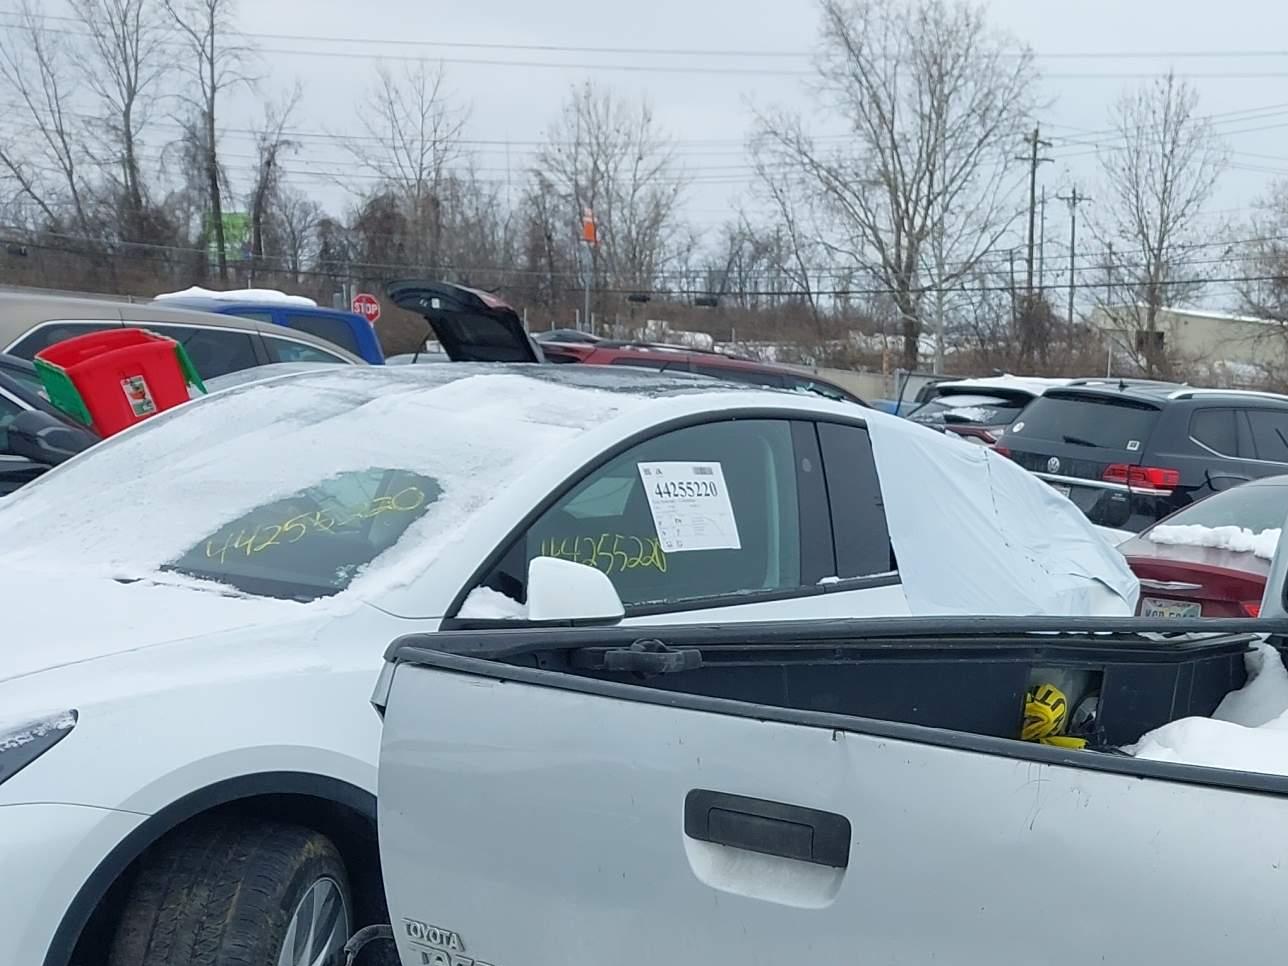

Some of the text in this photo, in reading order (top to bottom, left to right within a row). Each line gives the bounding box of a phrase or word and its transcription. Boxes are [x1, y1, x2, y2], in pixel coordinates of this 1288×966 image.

[354, 302, 378, 314] STOP
[655, 481, 718, 499] 44255220
[401, 917, 465, 952] TOYOTA
